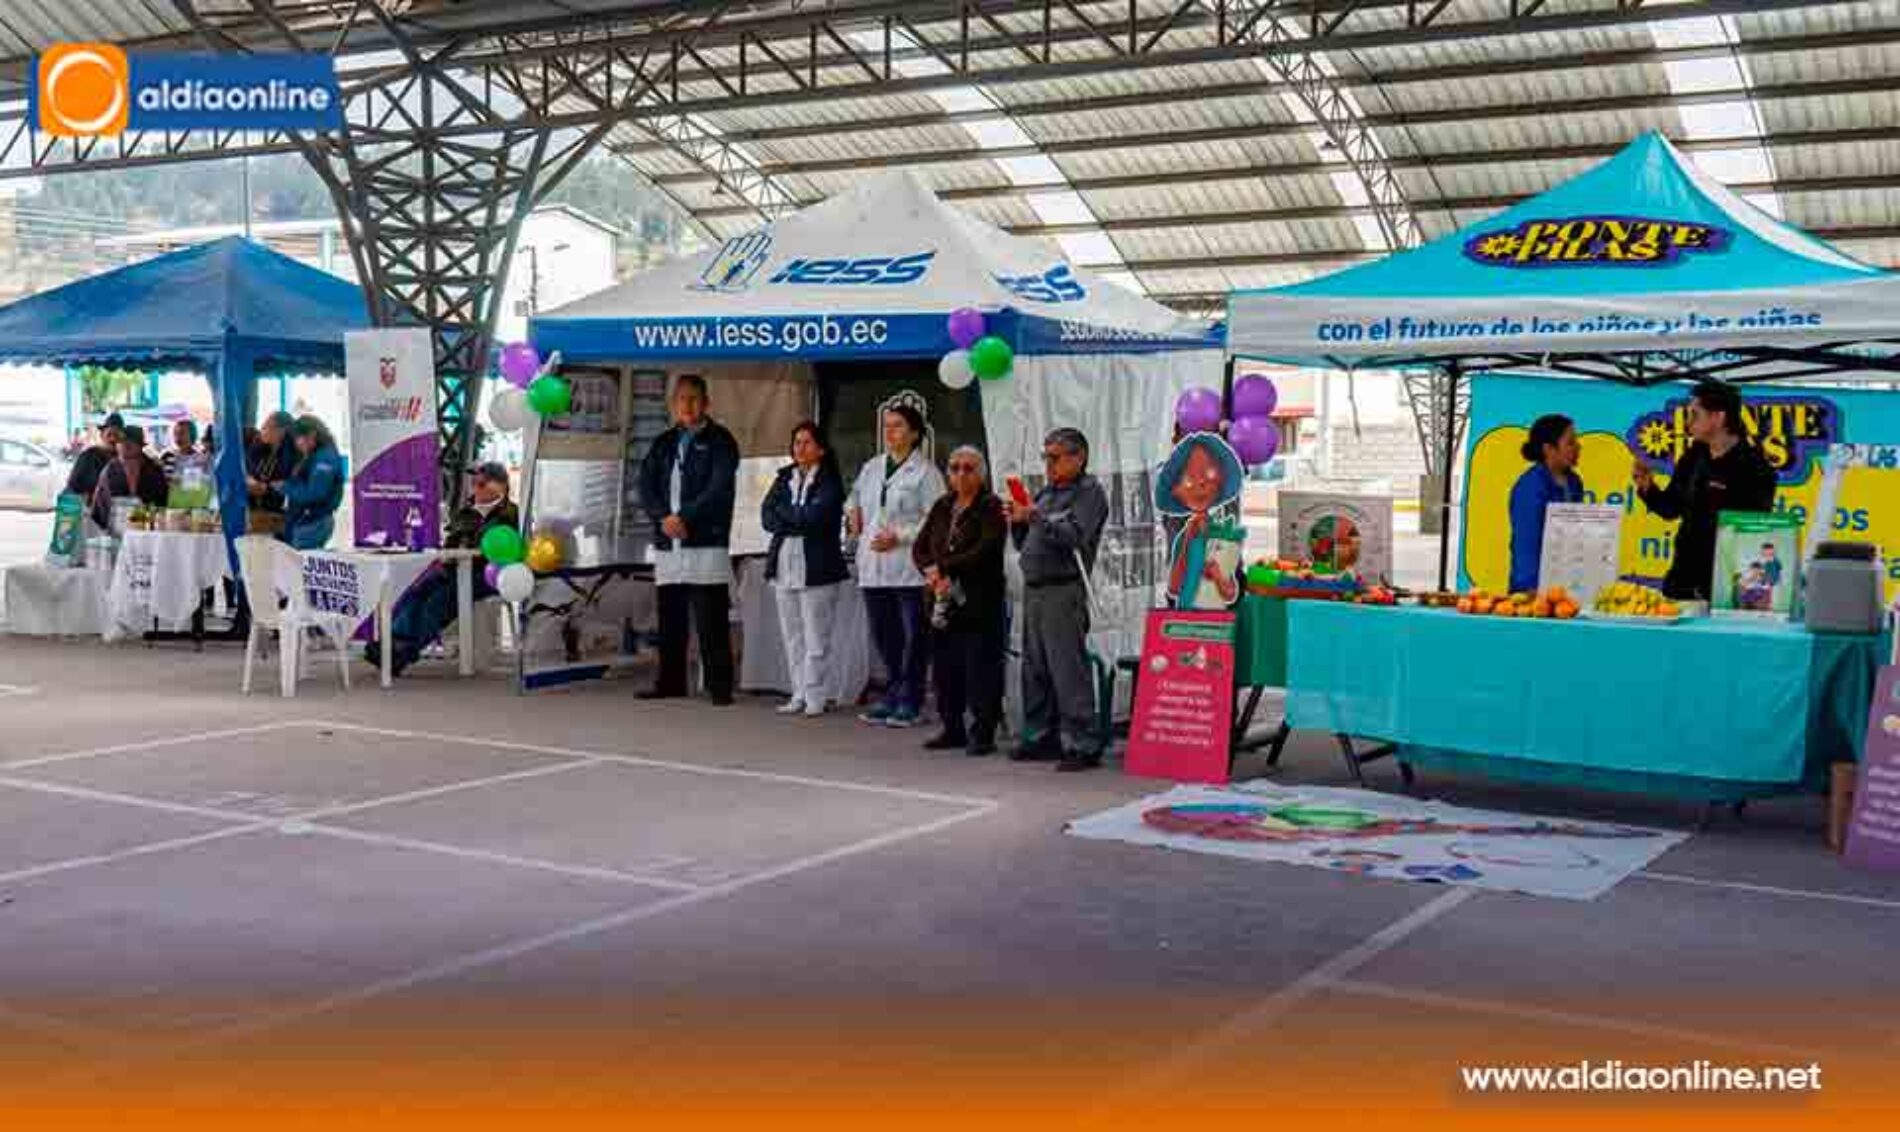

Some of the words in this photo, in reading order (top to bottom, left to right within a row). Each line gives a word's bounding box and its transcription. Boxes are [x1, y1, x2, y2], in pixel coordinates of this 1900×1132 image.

[634, 317, 888, 350] www.iess.gob.ec
[1317, 322, 1363, 342] con
[1368, 317, 1392, 341] el
[1398, 317, 1485, 339] futuro
[1491, 317, 1524, 335] de
[1606, 484, 1634, 515] el
[303, 556, 358, 580] JUNTOS
